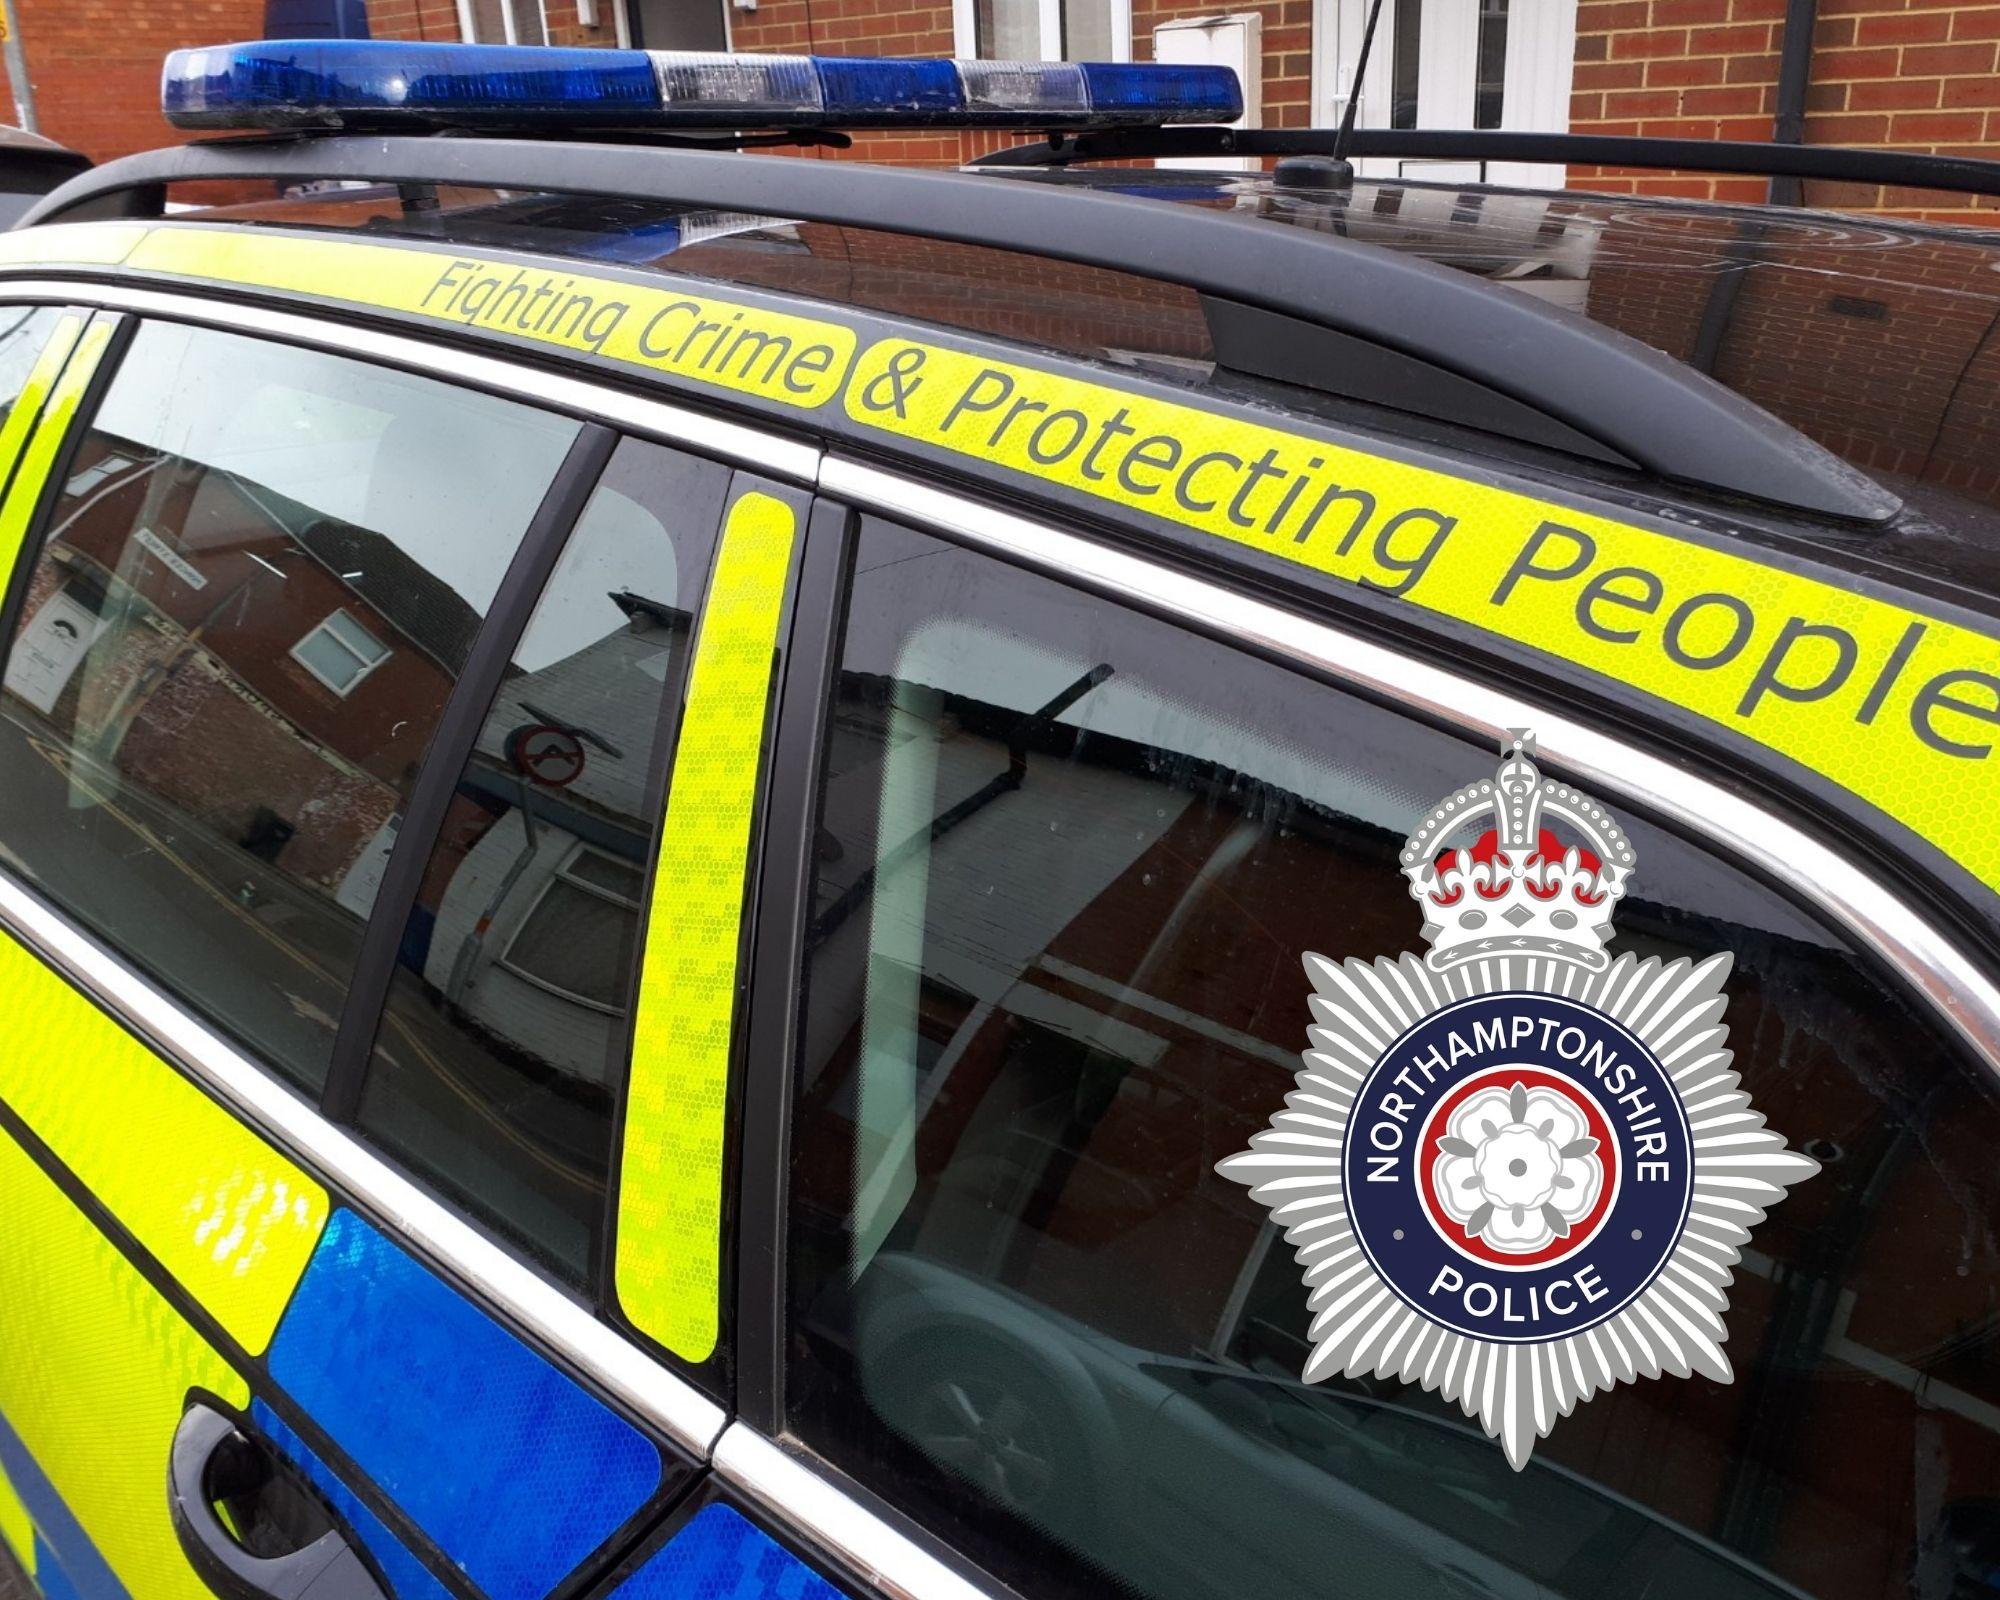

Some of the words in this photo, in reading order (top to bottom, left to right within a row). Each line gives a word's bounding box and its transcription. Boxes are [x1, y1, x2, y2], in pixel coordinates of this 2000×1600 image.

[420, 261, 630, 355] Fighting
[638, 301, 834, 393] Crime
[862, 348, 926, 419] &
[939, 368, 1458, 598] Protecting
[1489, 520, 2000, 759] People
